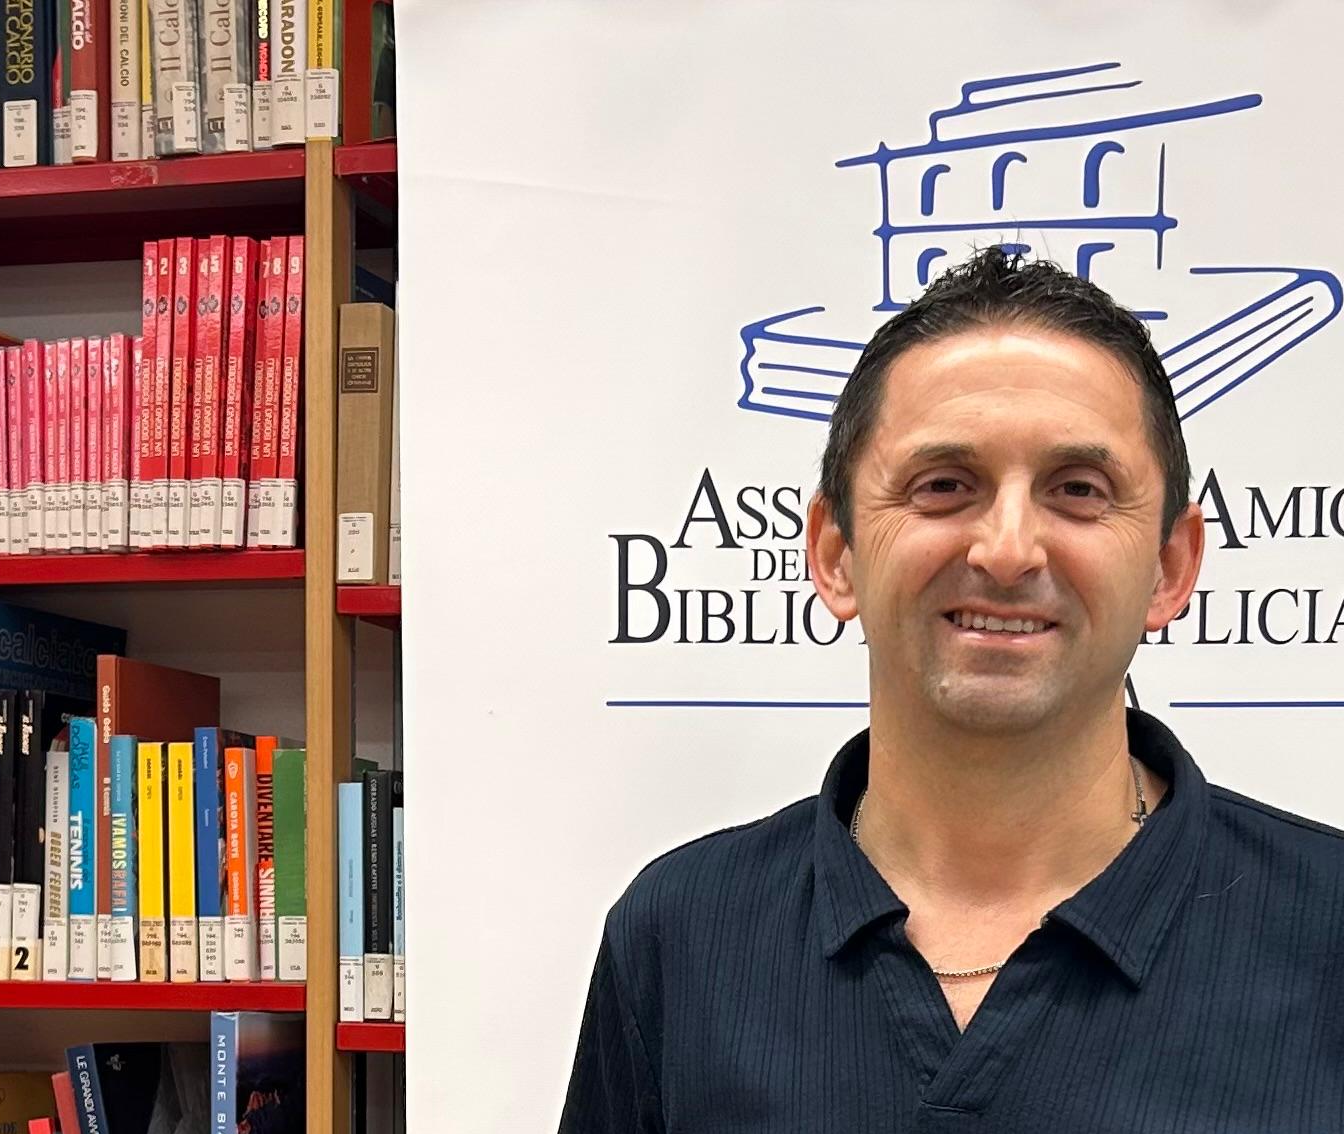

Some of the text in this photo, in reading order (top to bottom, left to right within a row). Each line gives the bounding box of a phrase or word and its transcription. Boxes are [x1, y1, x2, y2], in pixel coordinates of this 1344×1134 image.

[670, 467, 803, 548] ASS
[608, 534, 869, 645] BIBLIO
[70, 811, 83, 891] TENNIS
[257, 774, 274, 861] DIVENTARE
[79, 1072, 96, 1111] GRANDI
[216, 1034, 226, 1102] MONTE
